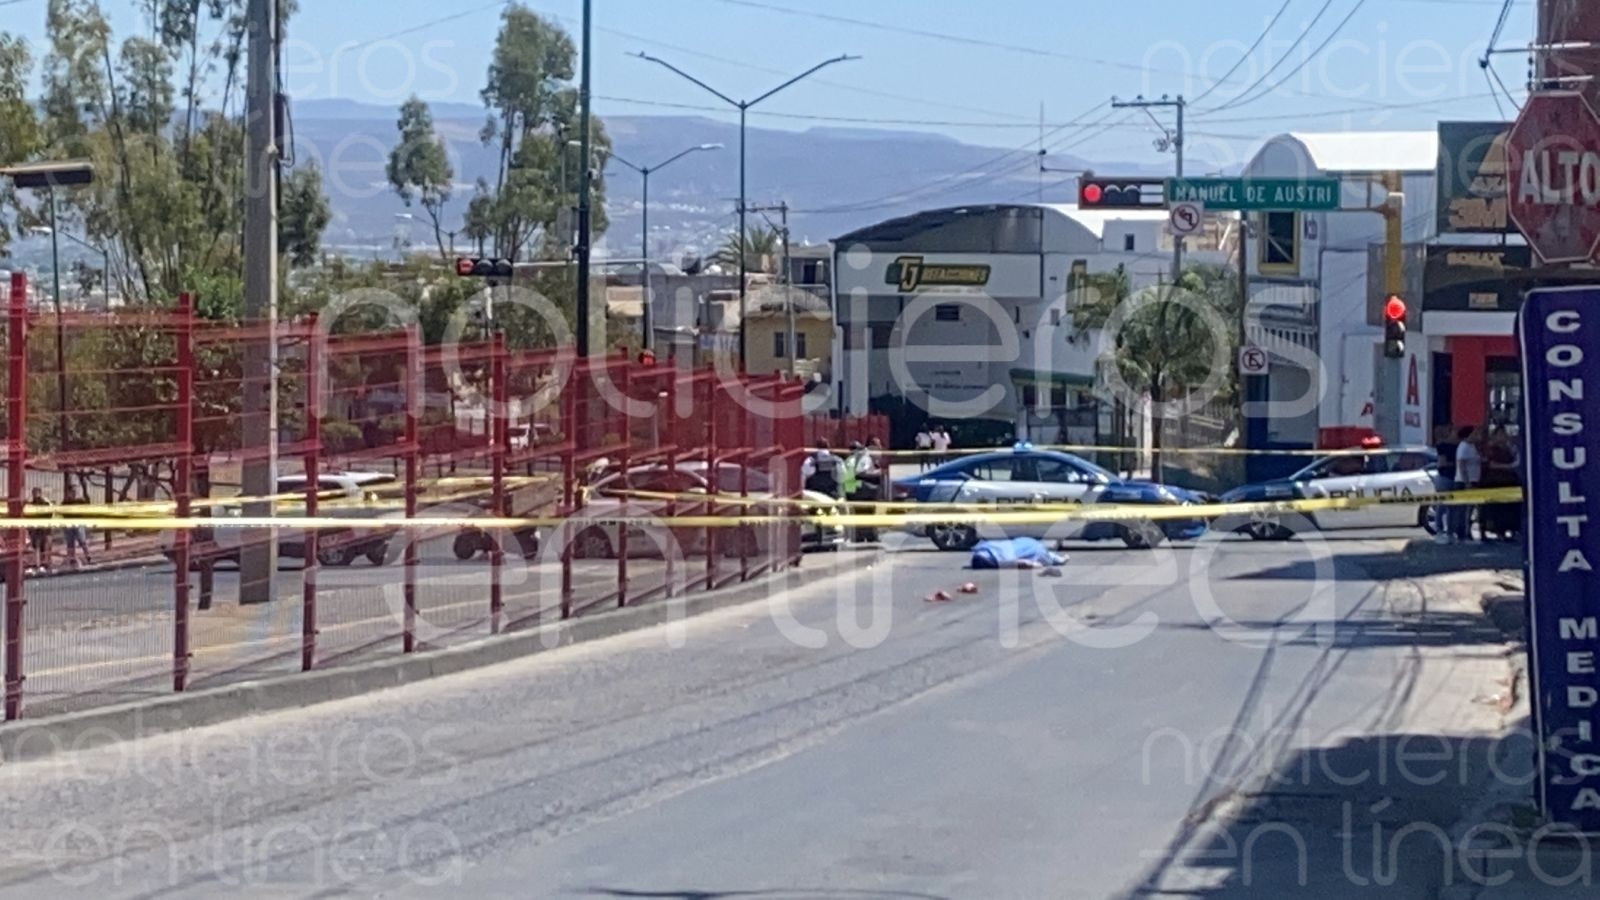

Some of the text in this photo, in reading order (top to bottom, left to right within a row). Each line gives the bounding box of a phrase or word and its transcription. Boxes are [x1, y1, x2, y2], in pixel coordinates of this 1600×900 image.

[1175, 186, 1331, 202] MANUEL DE AUSTRI
[1518, 149, 1600, 204] ALTO
[1546, 310, 1592, 571] CONSULTA
[1558, 617, 1600, 810] MEDICA
